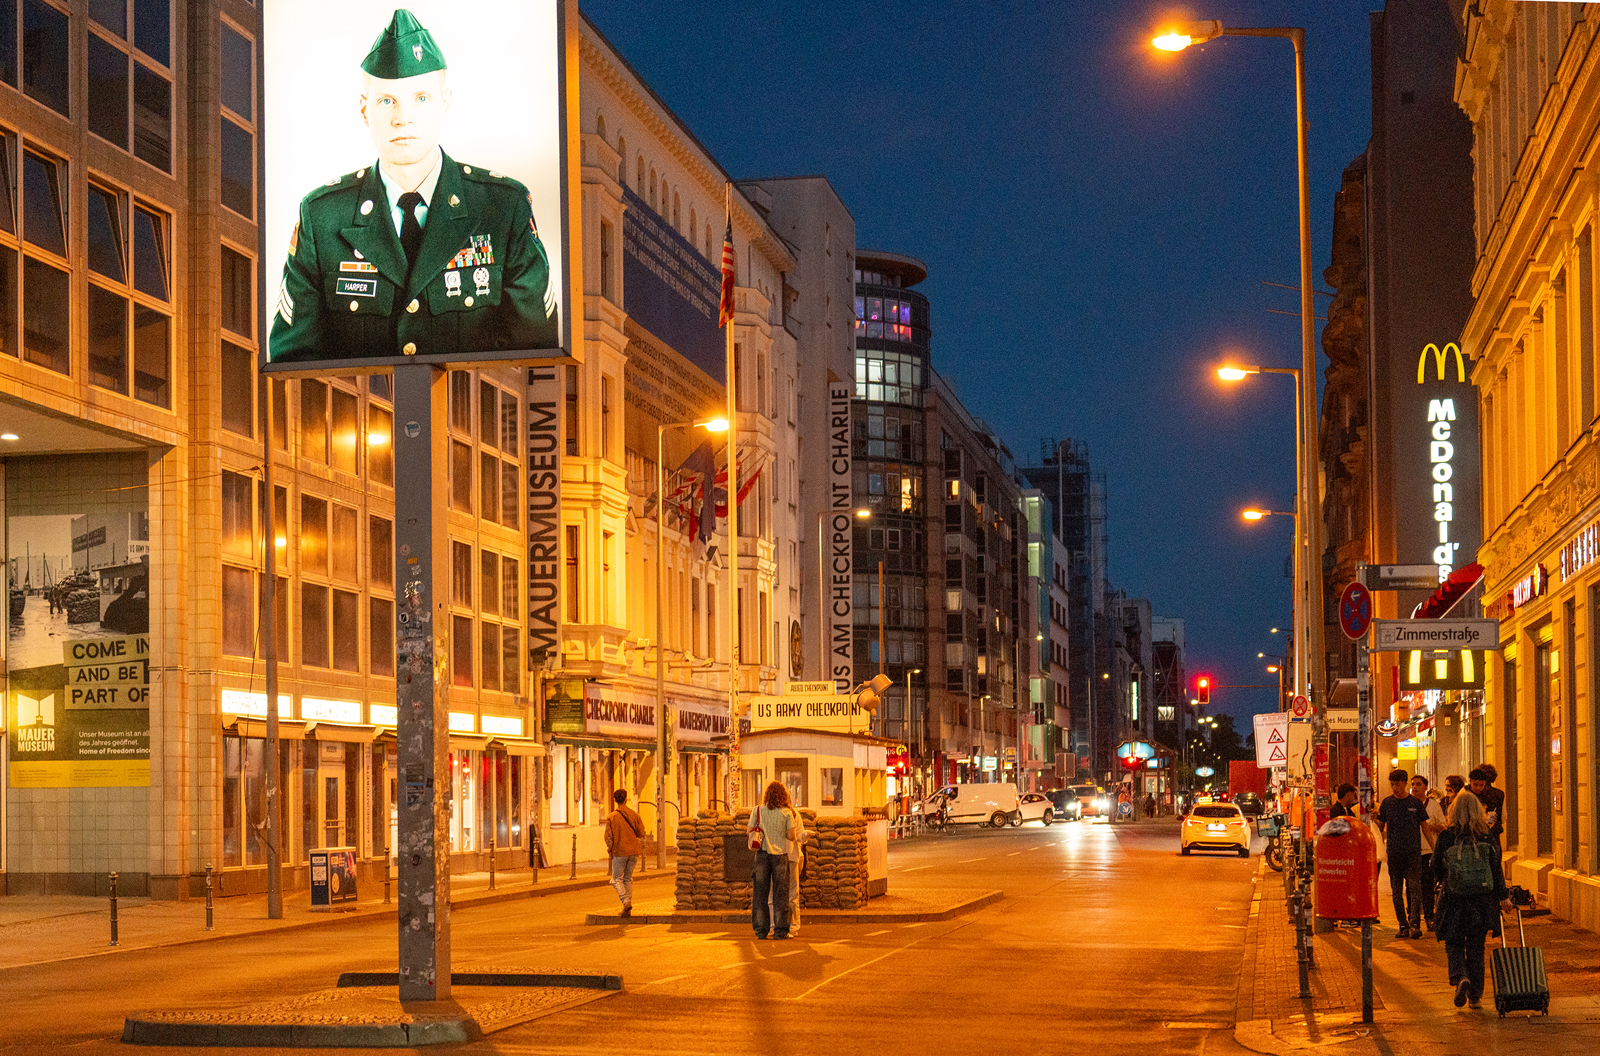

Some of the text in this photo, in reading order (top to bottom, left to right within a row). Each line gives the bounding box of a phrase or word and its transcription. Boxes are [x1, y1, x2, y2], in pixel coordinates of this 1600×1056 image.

[345, 283, 368, 292] HARPER
[1427, 398, 1460, 585] McDonald's
[528, 365, 557, 657] MAUERMUSEUM T
[832, 389, 851, 695] US AM CHECKPOINT CHARLIE
[1395, 627, 1480, 643] Zimmerstraße
[72, 638, 149, 659] COME IN
[76, 666, 138, 682] AND BE
[71, 687, 149, 704] PART OF
[790, 683, 829, 692] ALLIED CHECKPOINT
[586, 697, 628, 723] CHECKPOINT
[629, 703, 655, 726] CHARLIE
[758, 701, 862, 718] US ARMY CHECKPONT
[18, 728, 55, 741] MAUER
[17, 741, 55, 752] MUSEUM
[91, 739, 111, 747] Jahres
[1319, 858, 1355, 866] Kinderleicht
[1318, 868, 1347, 876] einwerfen
